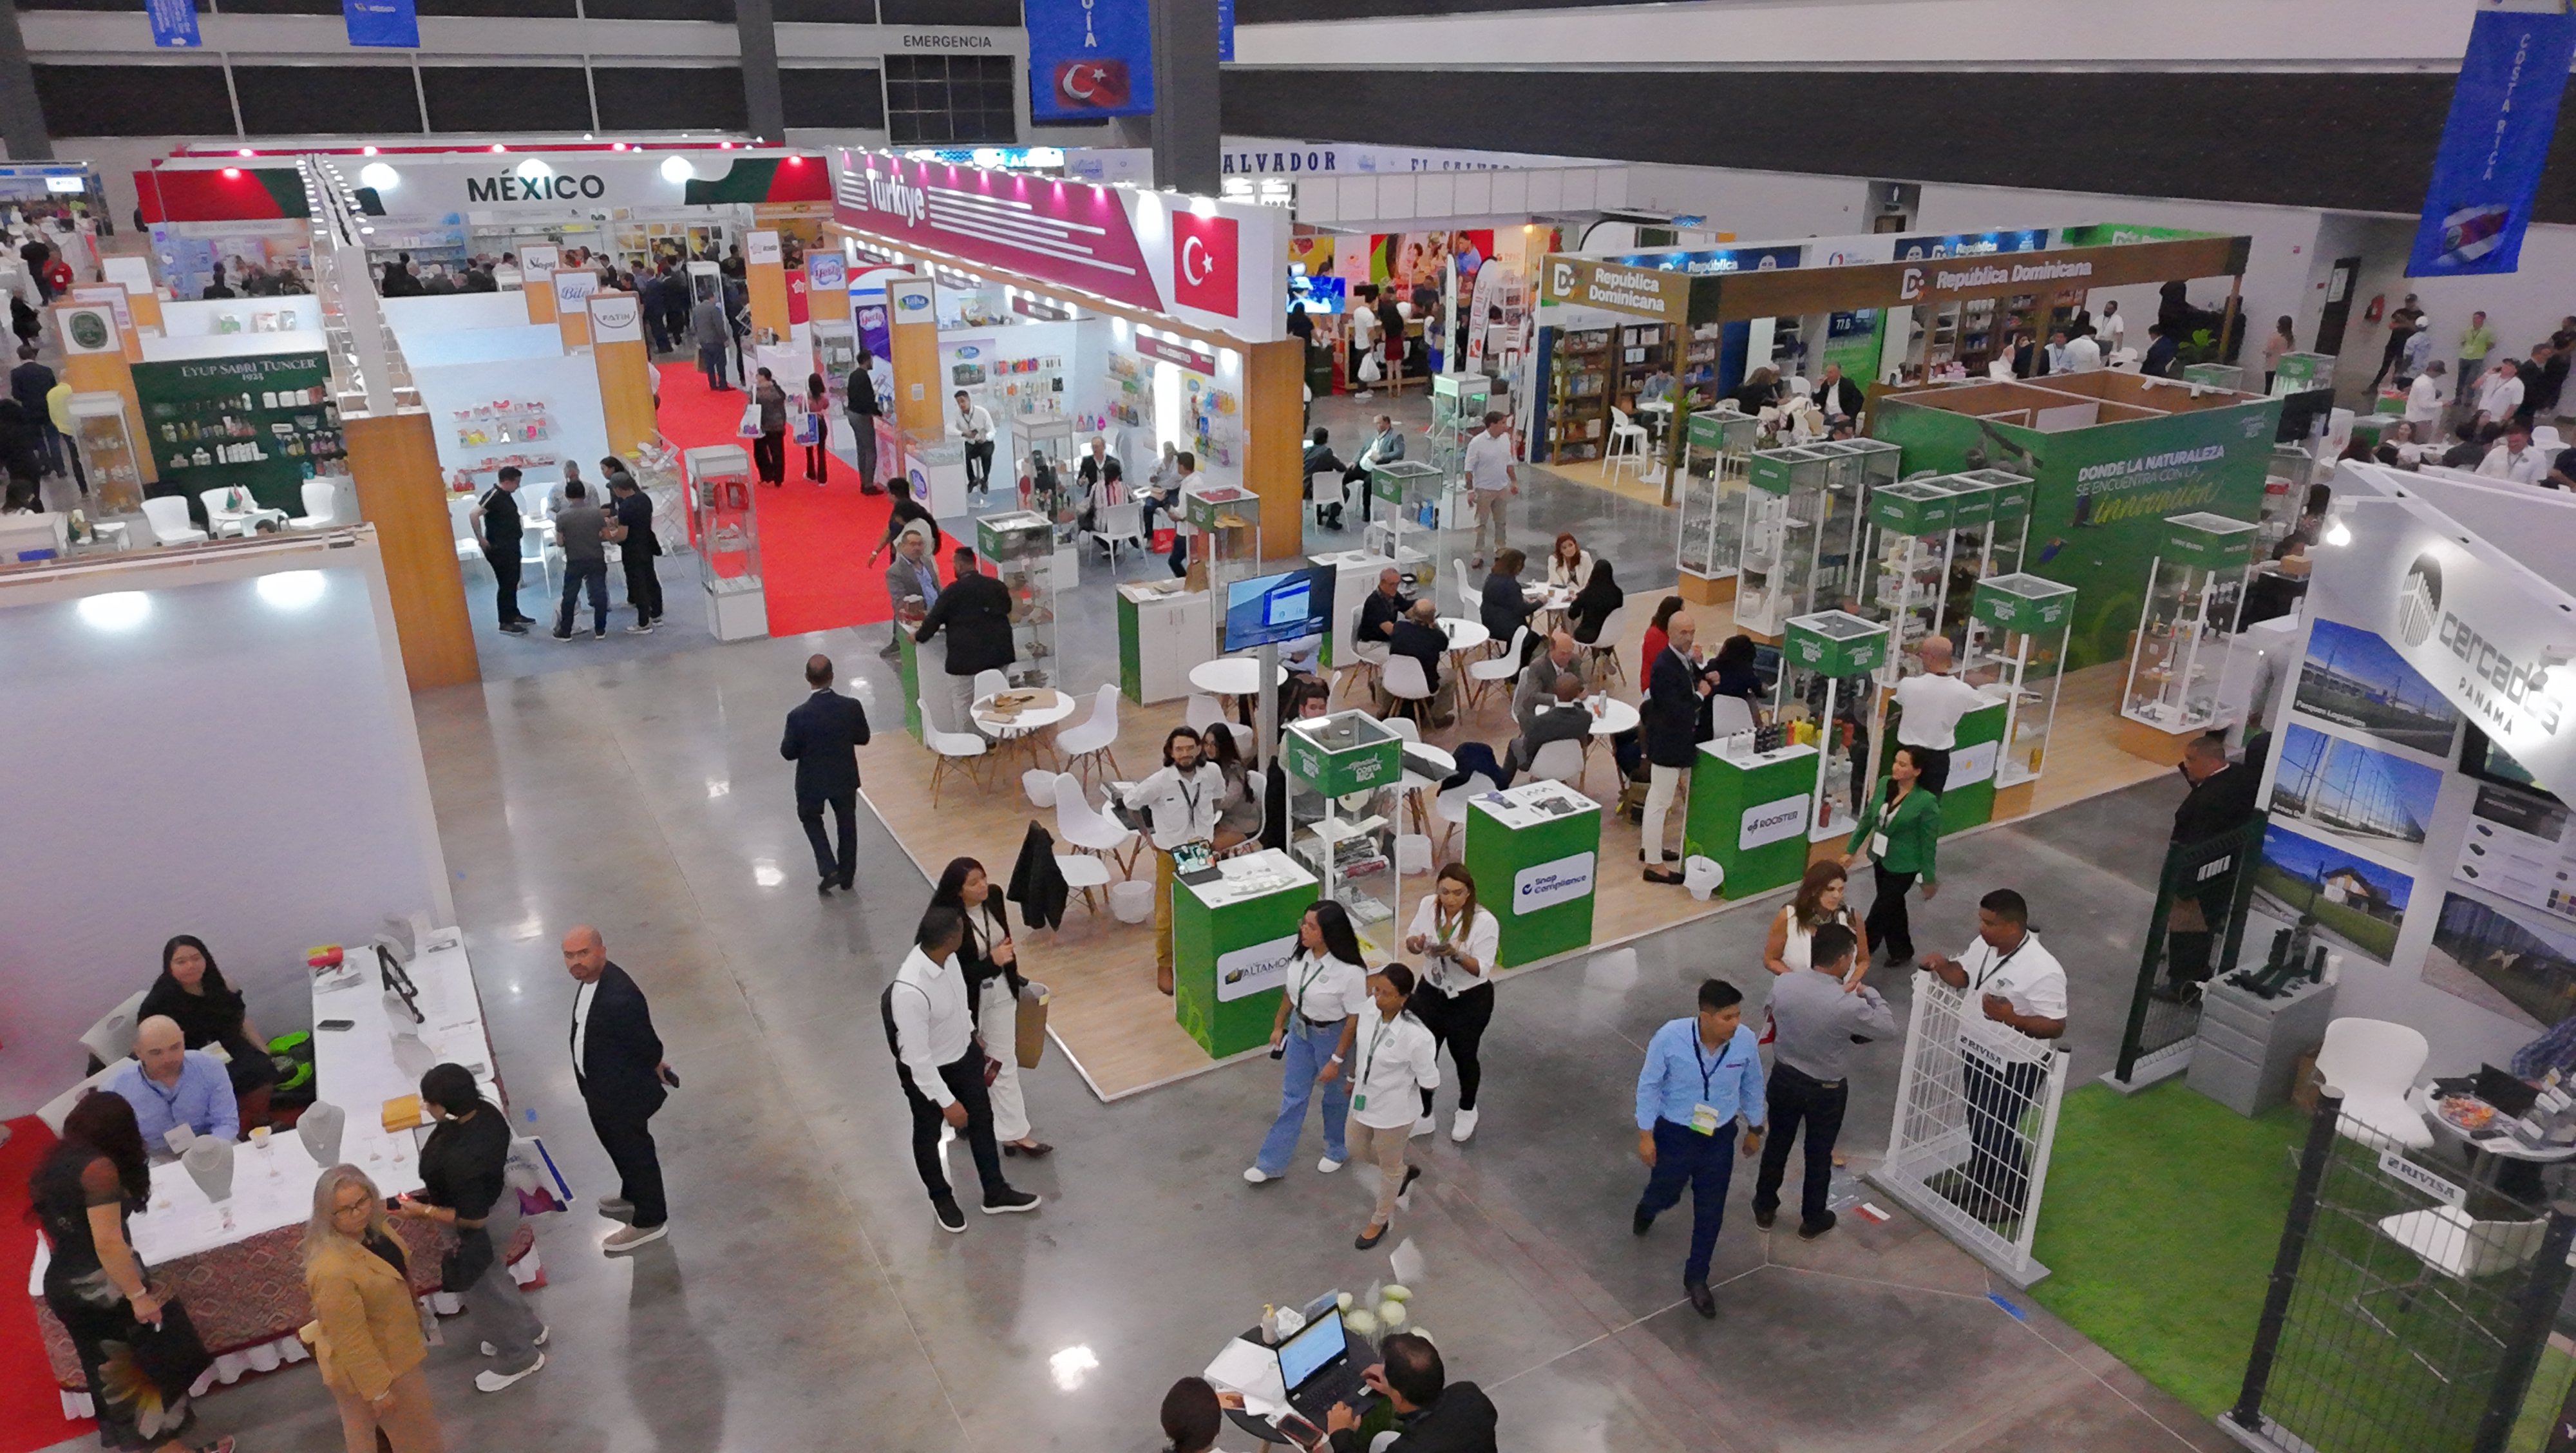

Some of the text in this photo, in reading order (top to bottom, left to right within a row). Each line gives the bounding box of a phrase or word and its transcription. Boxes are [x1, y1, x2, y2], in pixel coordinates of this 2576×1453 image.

[903, 35, 992, 48] EMERGENCIA
[2483, 33, 2532, 181] COSTA RICA
[1223, 151, 1336, 174] ALVADOR
[466, 168, 605, 202] MÉXICO
[866, 168, 925, 228] Türkiye
[1937, 260, 2092, 292] República Dominicana
[1589, 285, 1665, 312] Dominicana
[2078, 445, 2225, 482] DONDE LA NATURALEZA
[2076, 482, 2091, 497] SE
[2092, 472, 2157, 494] ENCUENTRA
[1759, 811, 1798, 828] ROOSTER
[1968, 1040, 2002, 1065] RIVISA
[2400, 1163, 2455, 1199] RIVISA
